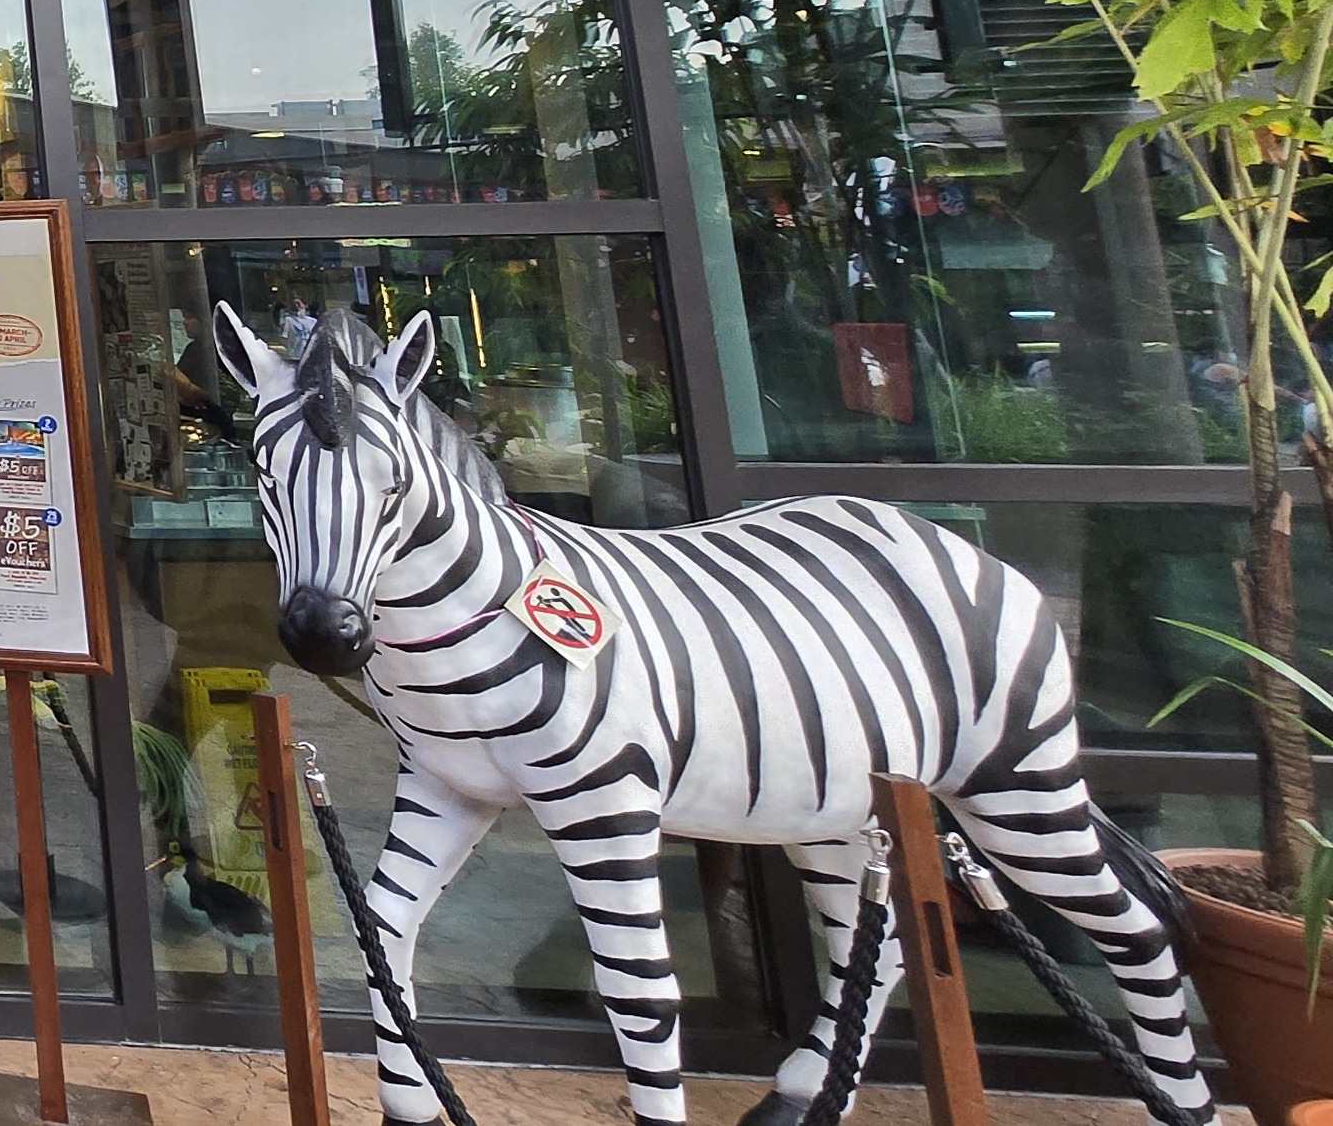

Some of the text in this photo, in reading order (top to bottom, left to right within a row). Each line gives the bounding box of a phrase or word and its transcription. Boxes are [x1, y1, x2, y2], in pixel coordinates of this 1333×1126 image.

[5, 336, 27, 344] APRIL
[3, 398, 37, 409] Prizes
[21, 465, 39, 474] OFF
[0, 510, 43, 538] $5
[5, 541, 39, 556] OFF
[0, 556, 47, 568] eVouchers
